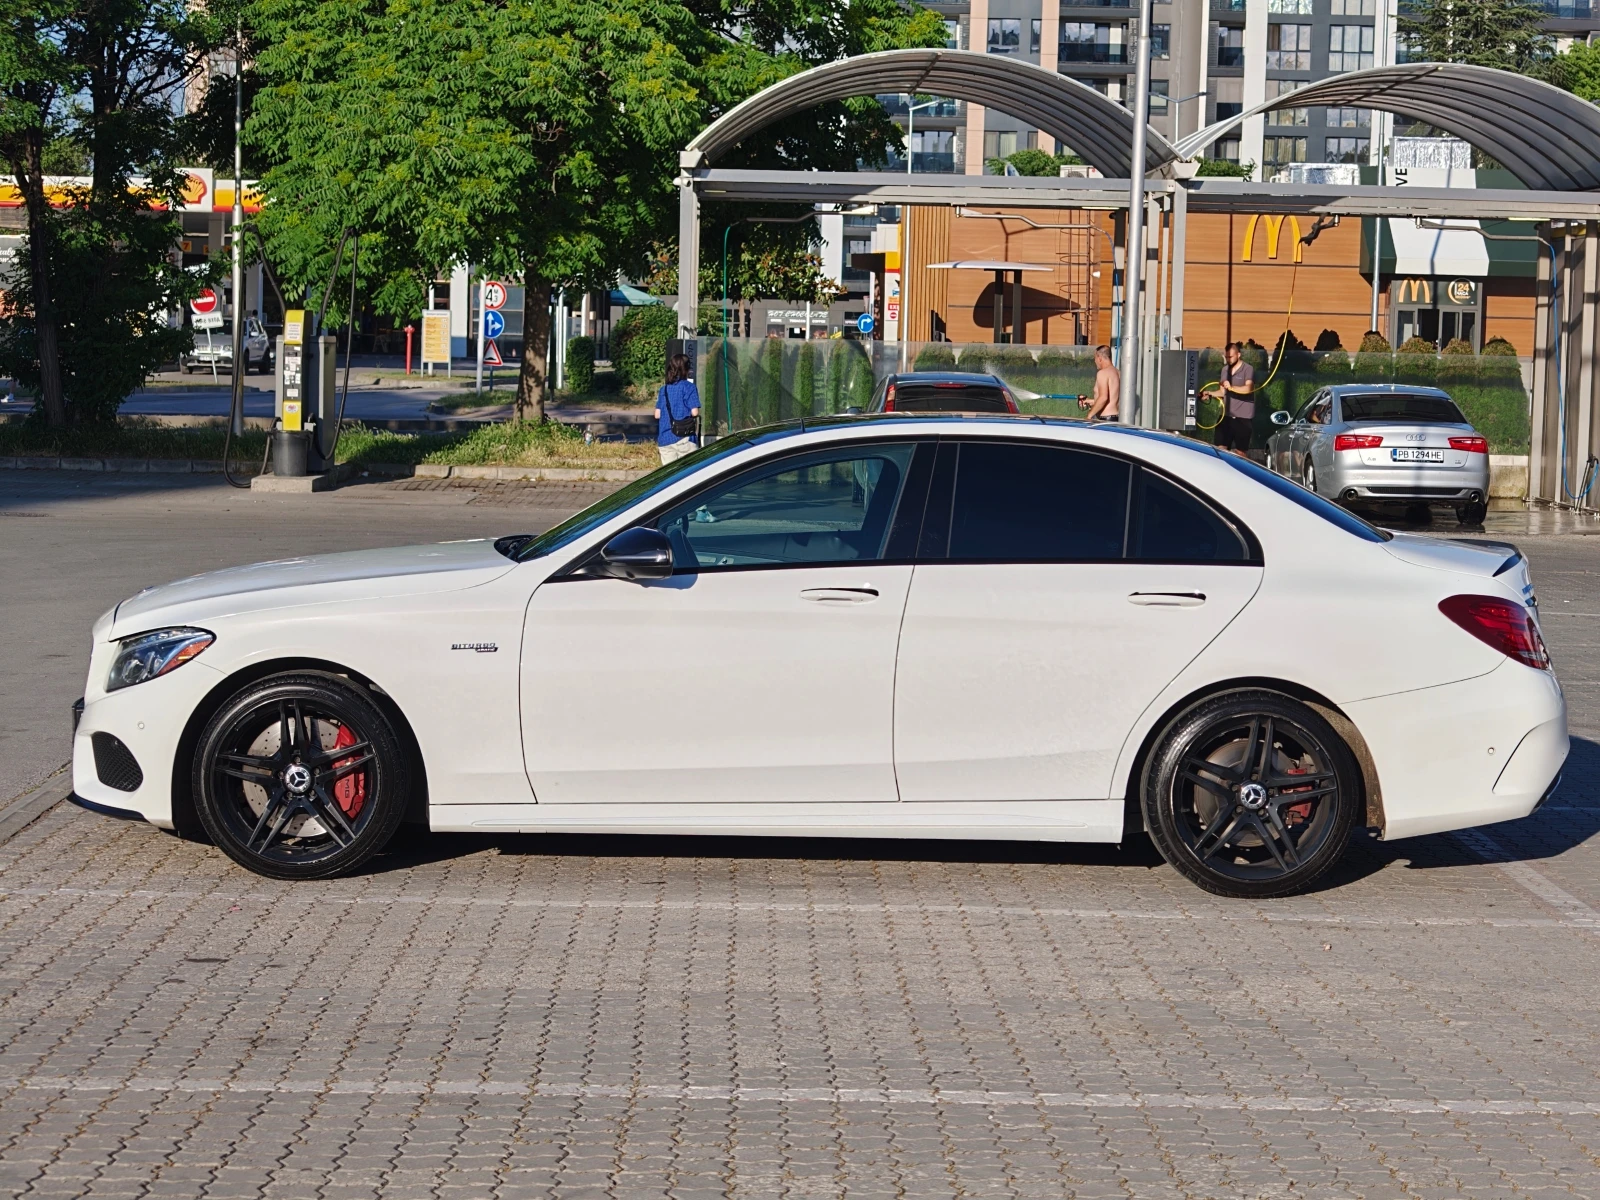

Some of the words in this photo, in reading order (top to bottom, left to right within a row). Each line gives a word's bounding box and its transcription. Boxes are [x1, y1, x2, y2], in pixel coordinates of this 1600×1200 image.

[1458, 283, 1469, 292] 24
[767, 310, 783, 318] HOT
[1398, 450, 1409, 459] PB
[1411, 451, 1430, 459] 1294
[1431, 451, 1442, 460] HE
